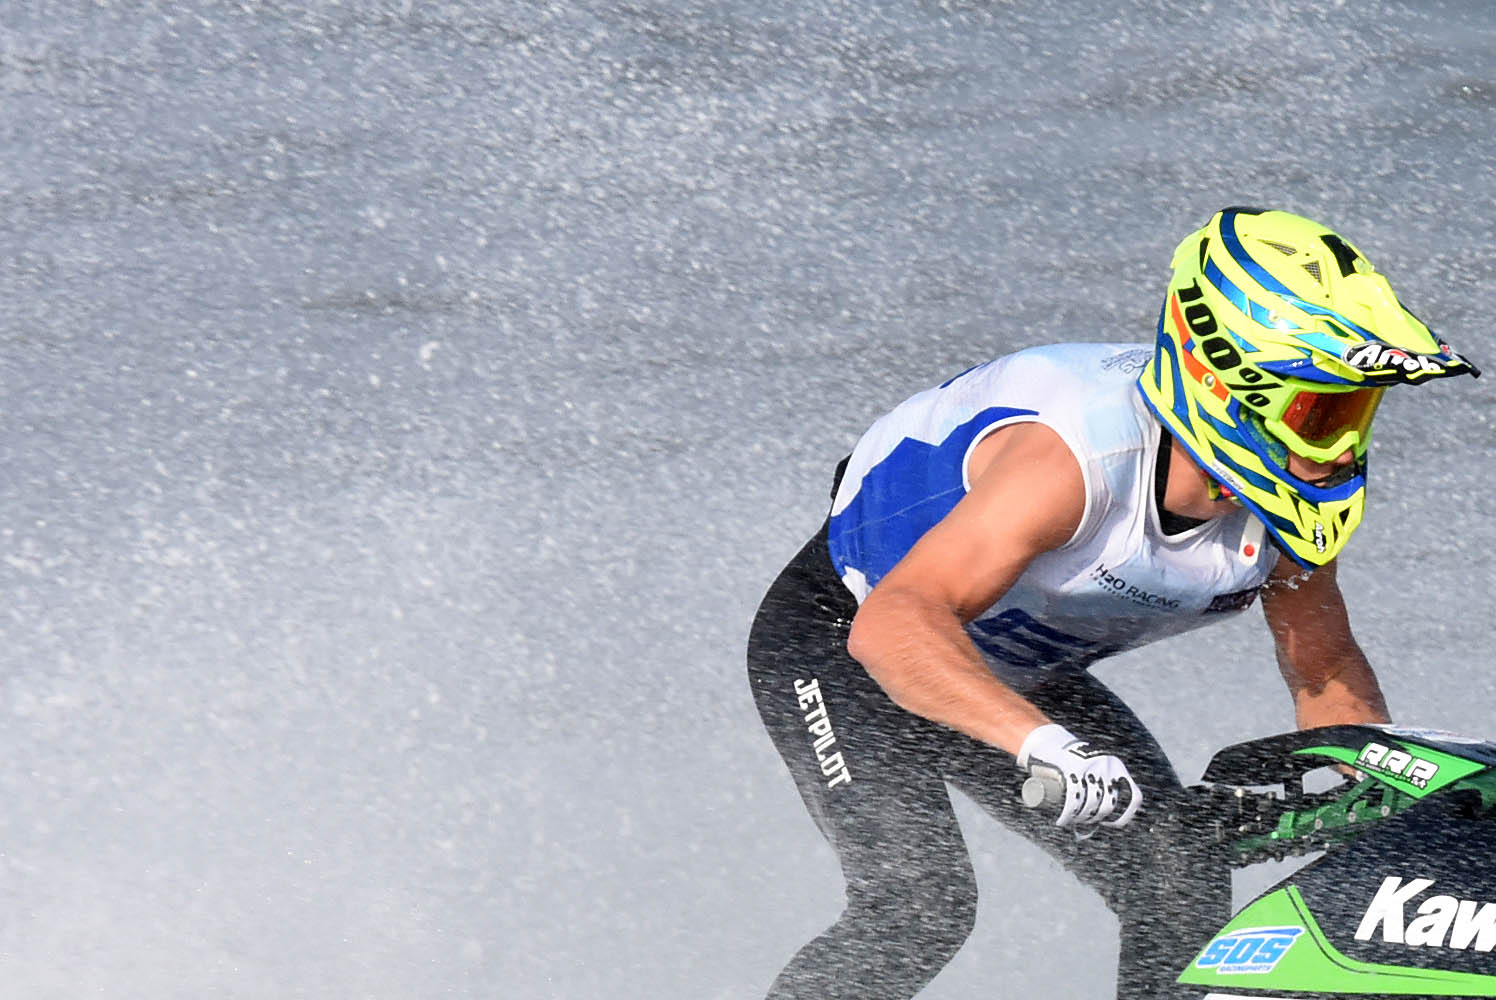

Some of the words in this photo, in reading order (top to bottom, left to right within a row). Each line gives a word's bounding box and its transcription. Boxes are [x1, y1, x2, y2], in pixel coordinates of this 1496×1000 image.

[1177, 277, 1284, 408] 100%
[1095, 562, 1126, 590] H2O
[1126, 585, 1180, 609] RACING
[793, 678, 852, 788] JETPILOT
[1197, 937, 1295, 966] SOS
